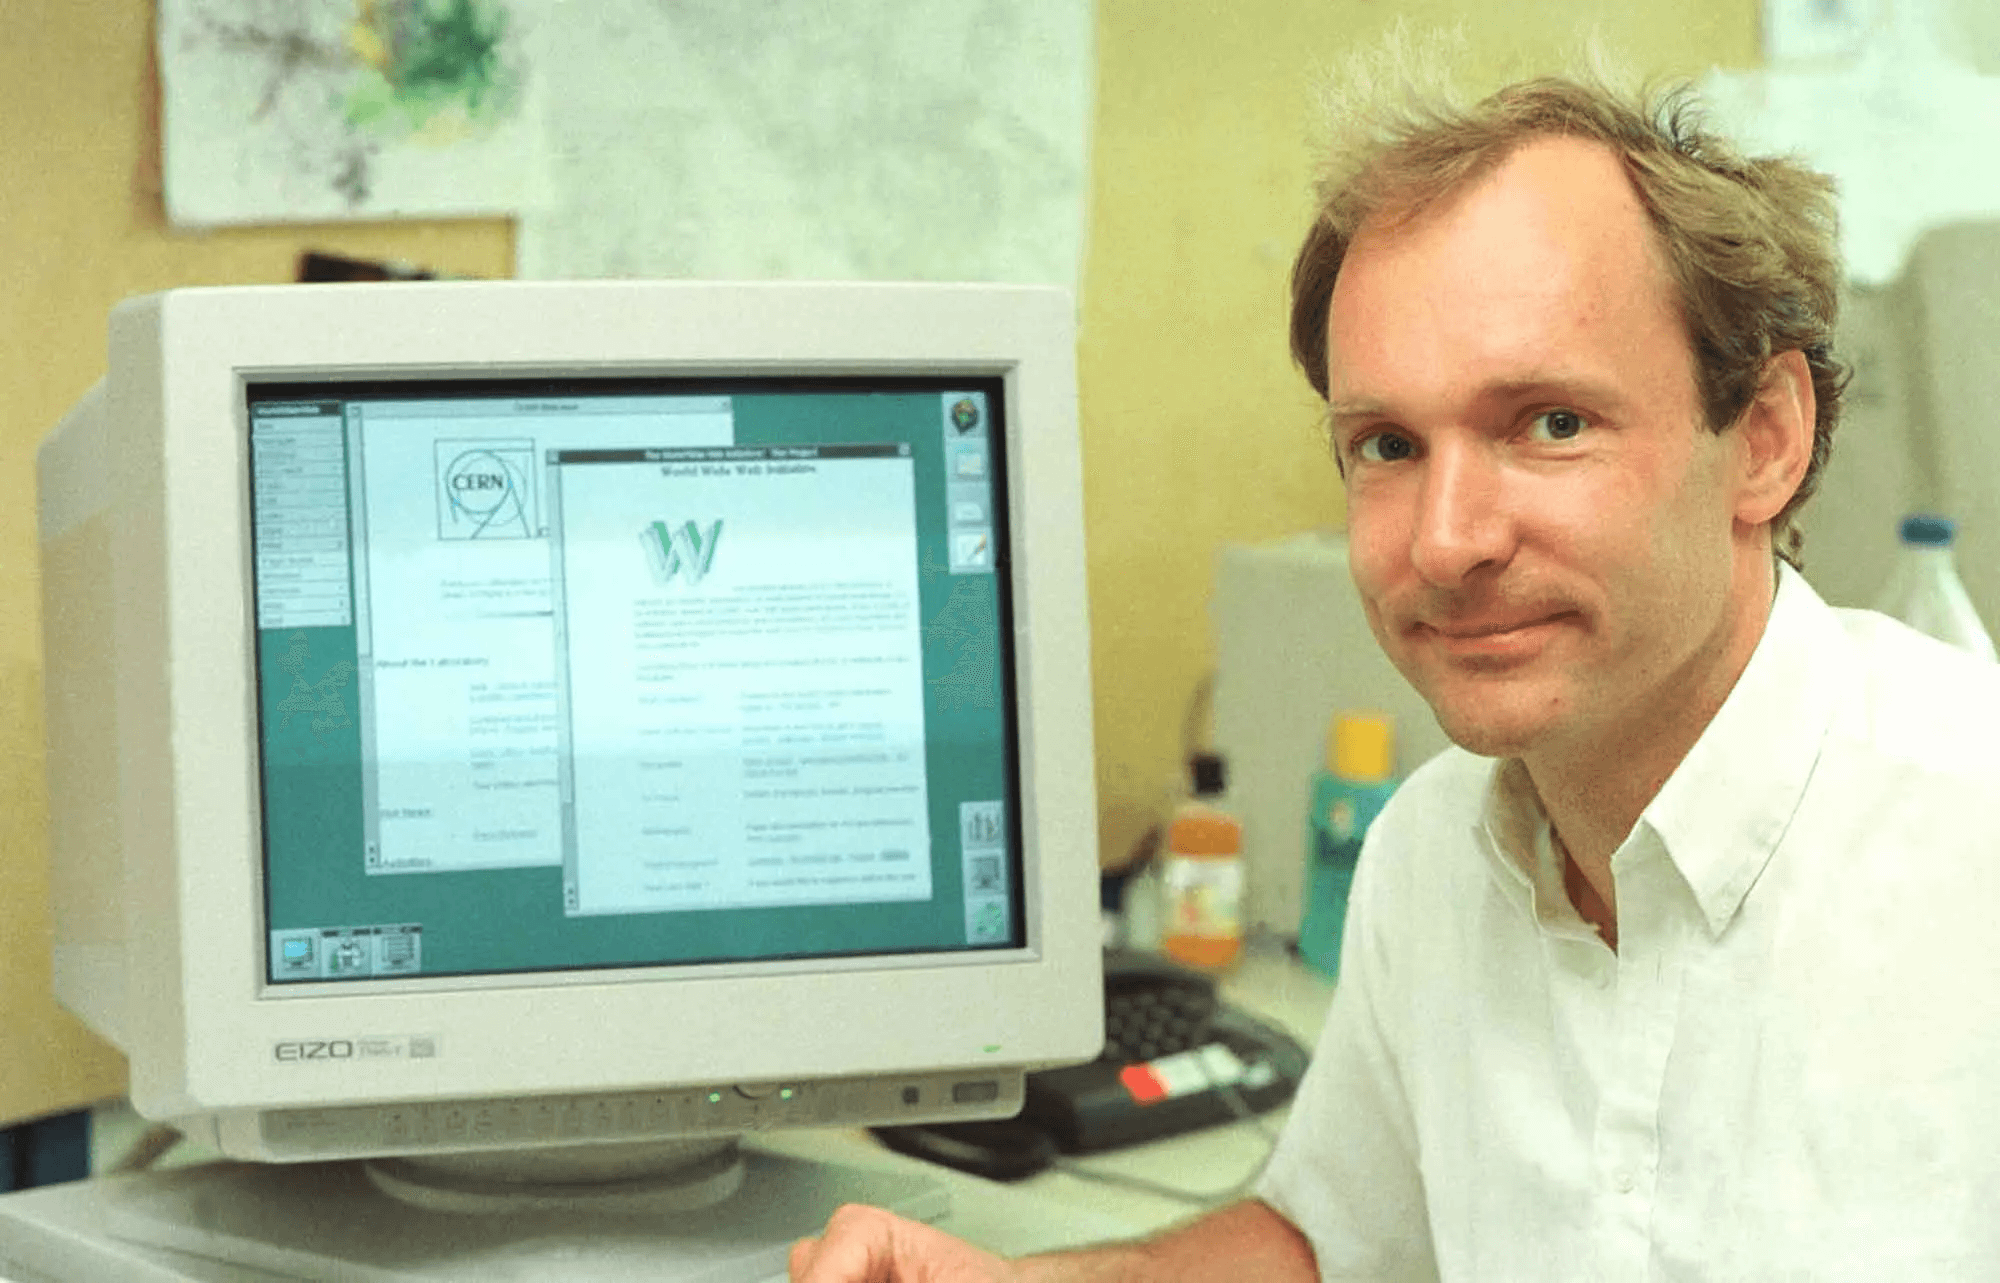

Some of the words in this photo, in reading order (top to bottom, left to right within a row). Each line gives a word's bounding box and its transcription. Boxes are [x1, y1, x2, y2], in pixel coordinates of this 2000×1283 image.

[661, 465, 698, 477] World
[735, 464, 763, 475] Web
[452, 474, 504, 490] CERN
[639, 519, 724, 587] W
[275, 1040, 354, 1061] EIZO
